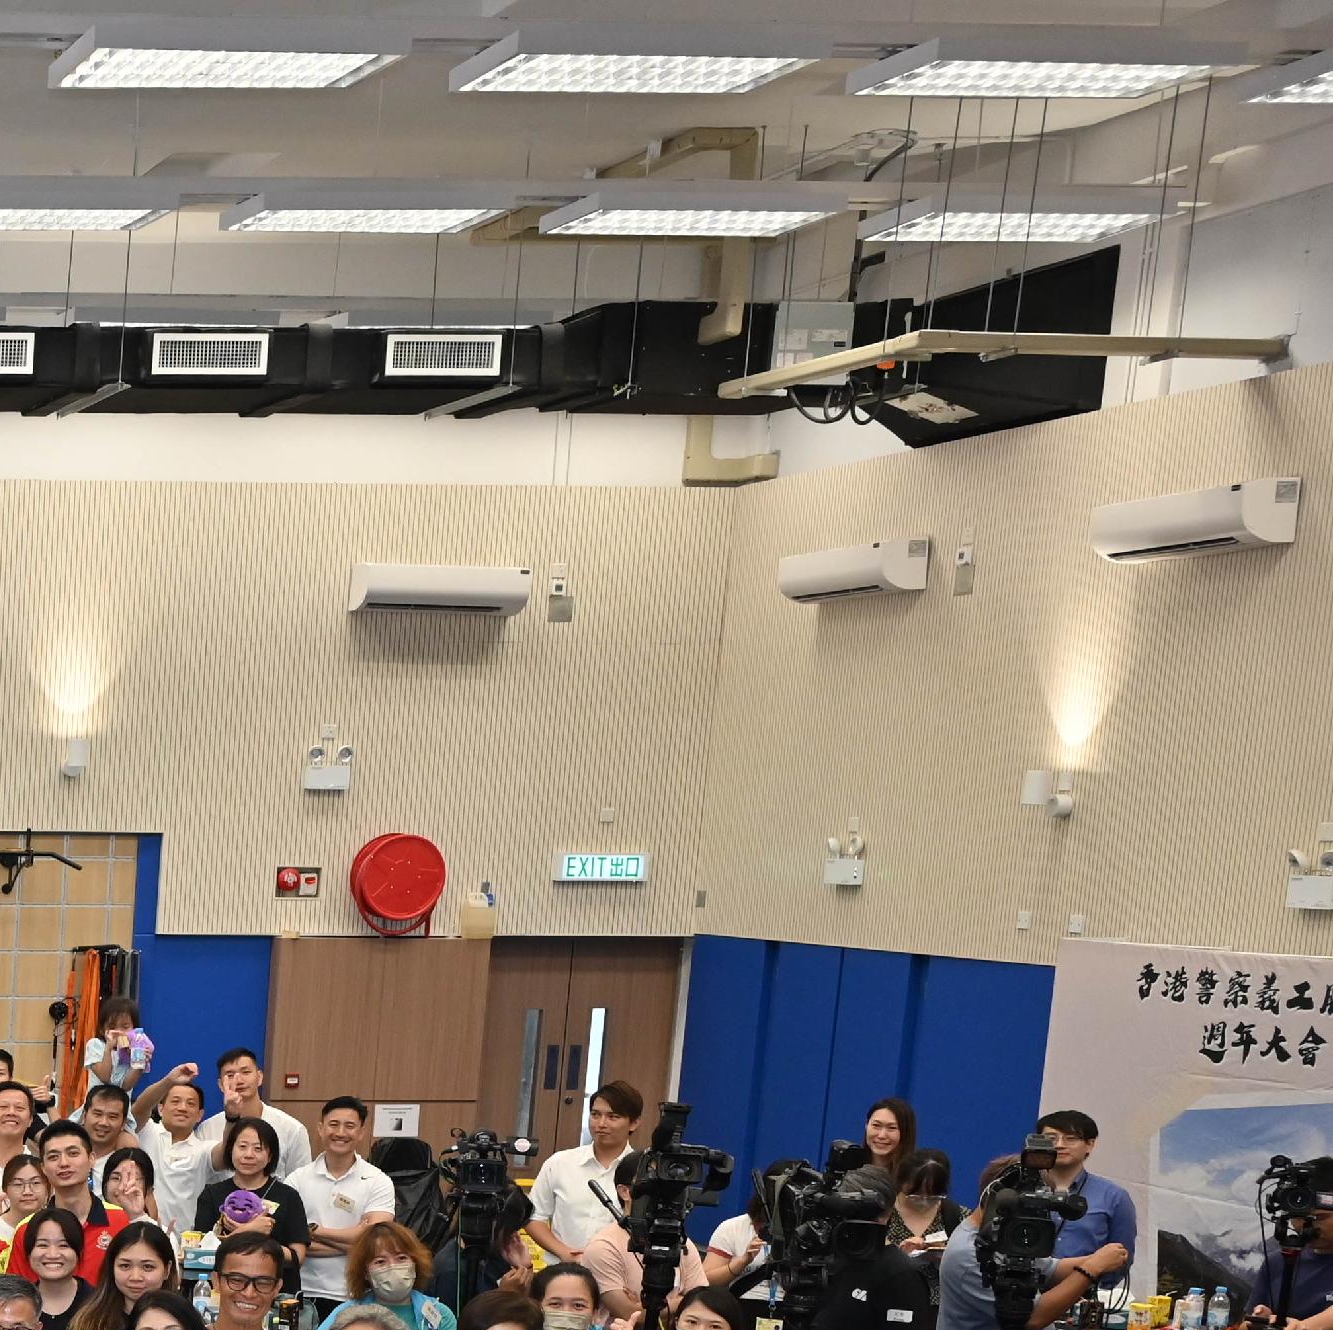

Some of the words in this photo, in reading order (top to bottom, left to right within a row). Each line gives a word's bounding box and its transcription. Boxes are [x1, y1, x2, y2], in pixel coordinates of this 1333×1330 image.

[567, 857, 605, 877] EXIT
[610, 857, 640, 876] 出口
[1199, 1021, 1327, 1067] 週年大會
